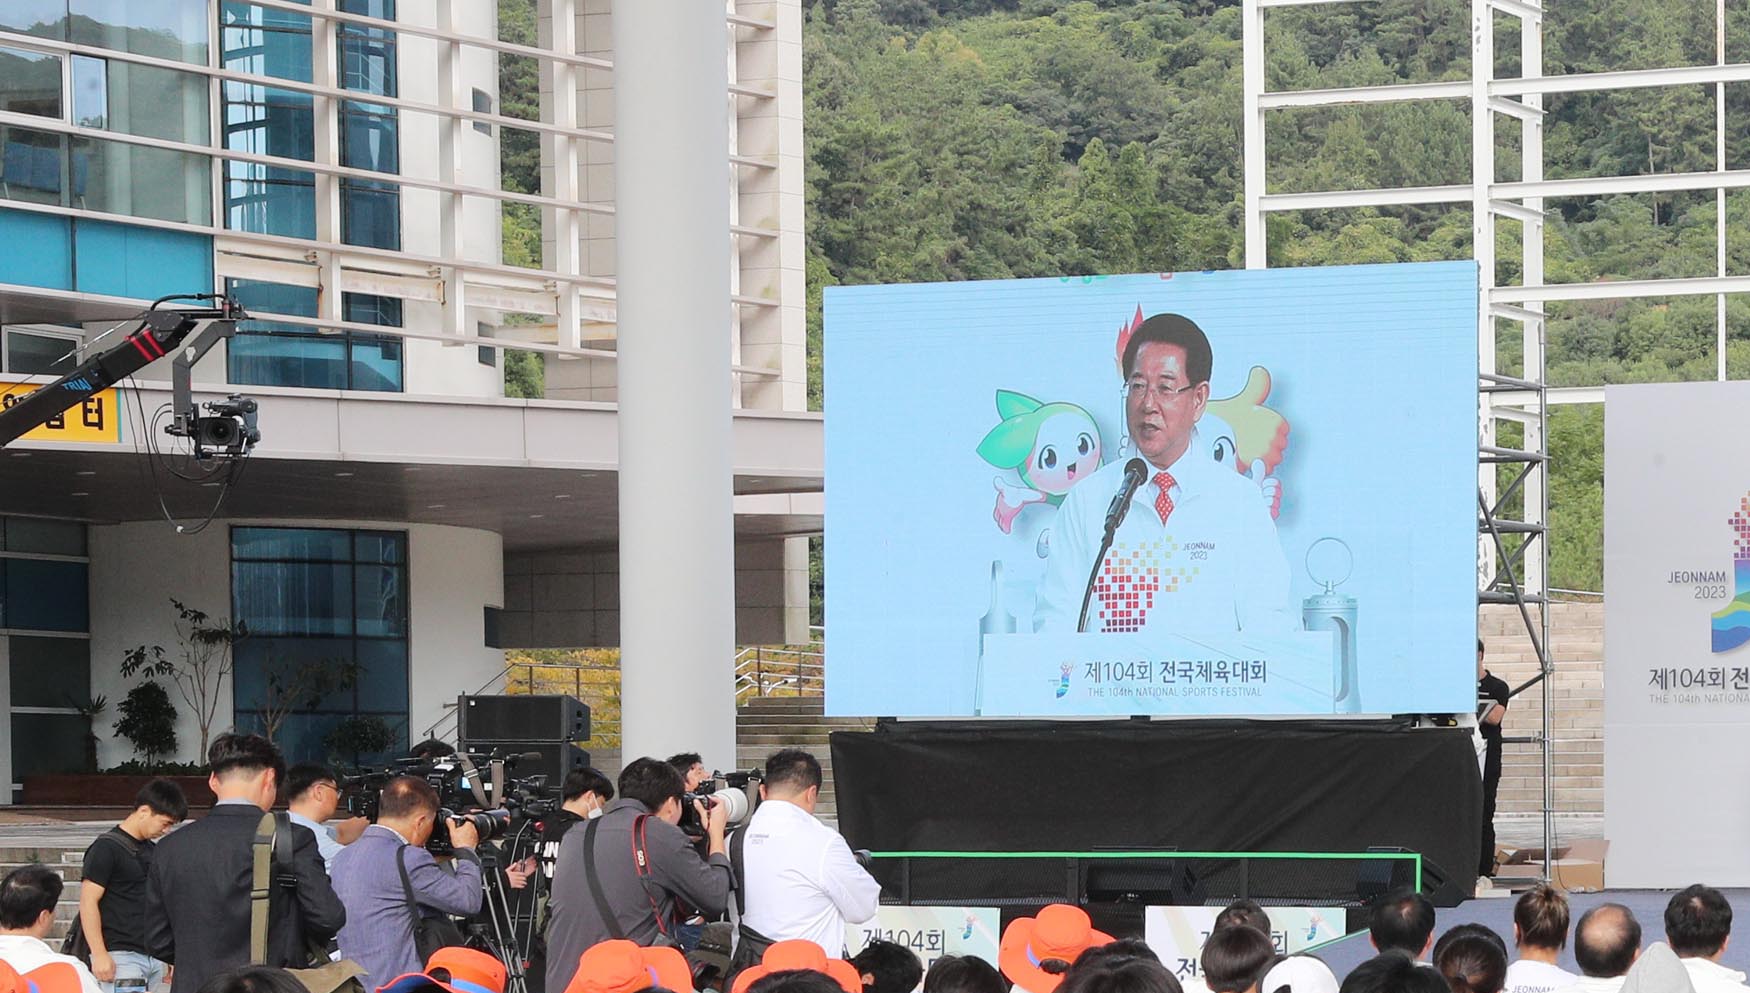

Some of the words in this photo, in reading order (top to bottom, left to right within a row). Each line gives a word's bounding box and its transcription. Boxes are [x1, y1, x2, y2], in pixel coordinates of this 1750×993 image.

[1190, 551, 1208, 561] 2023
[1668, 571, 1726, 584] JEONNAM
[1694, 585, 1726, 599] 2023
[1084, 661, 1153, 684] 제104회
[1159, 660, 1267, 684] 전국체육대회
[1648, 668, 1726, 690] 제104회
[1088, 688, 1104, 697] THE
[1108, 687, 1133, 697] 104th
[1136, 687, 1179, 697] NATIONAL
[1182, 687, 1218, 697] SPORTS
[1220, 687, 1262, 697] FESTIVAL
[1649, 694, 1669, 704] THE
[1672, 694, 1701, 704] 104th
